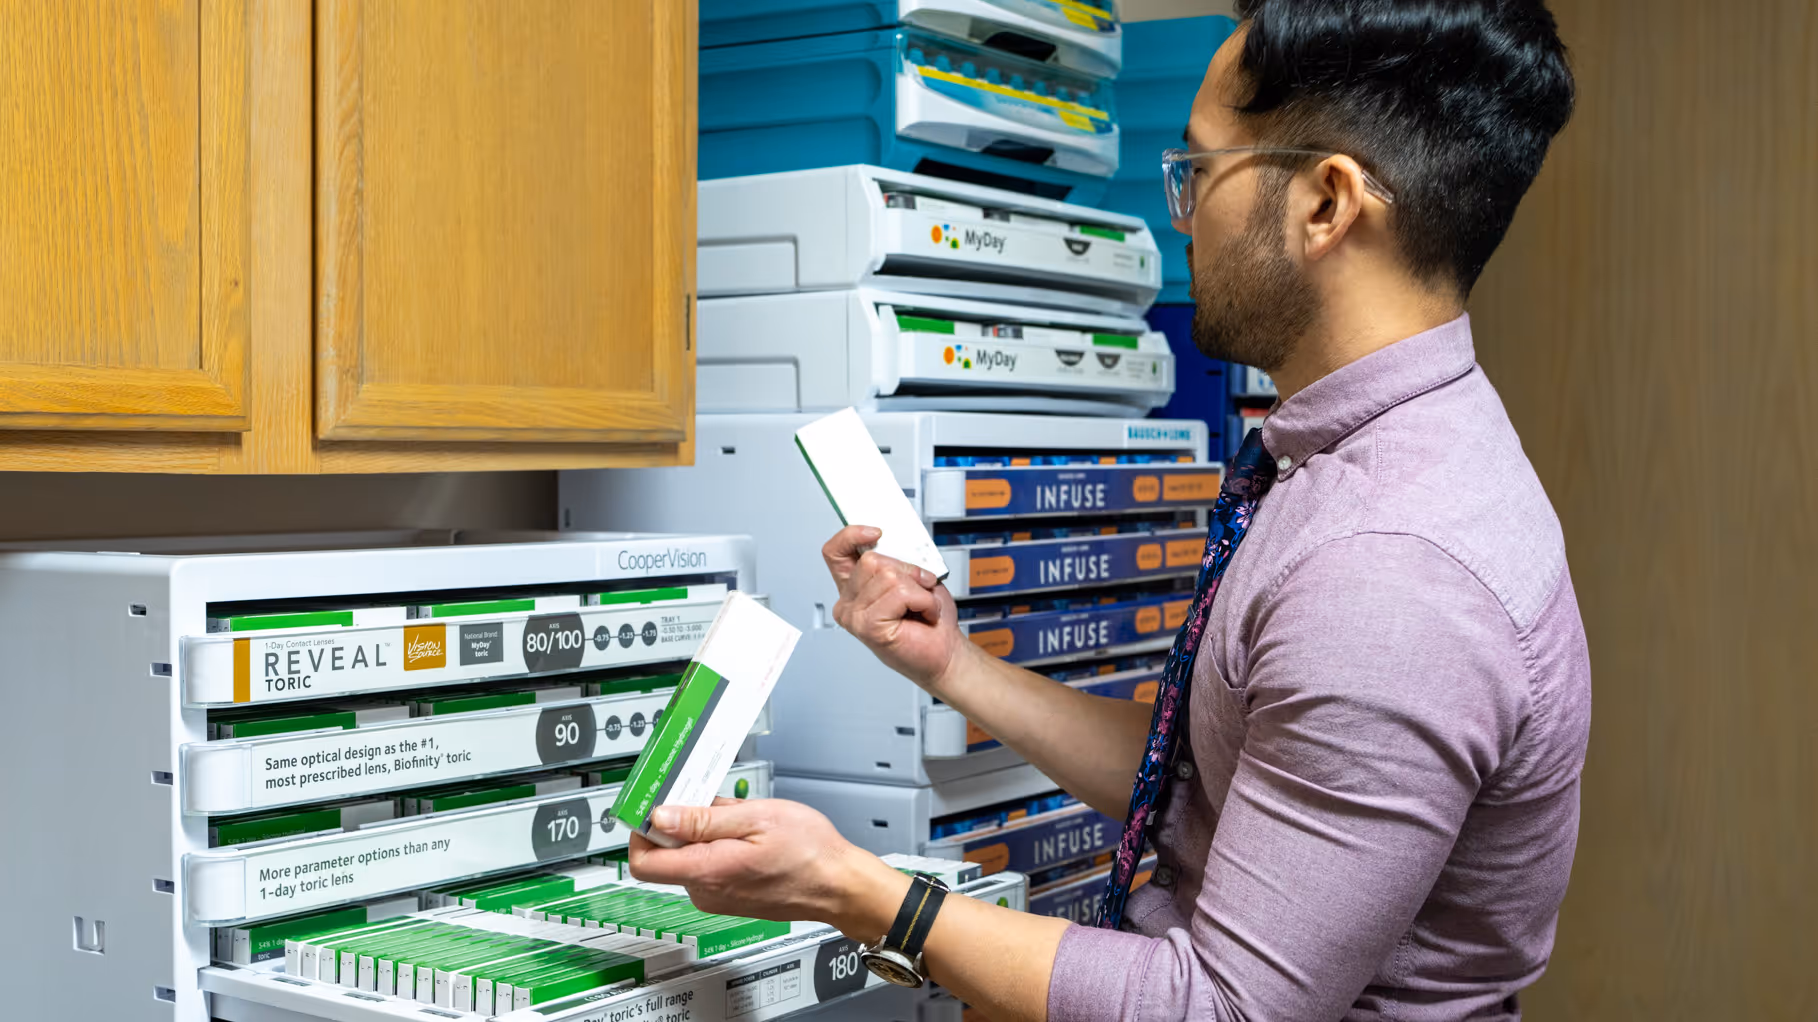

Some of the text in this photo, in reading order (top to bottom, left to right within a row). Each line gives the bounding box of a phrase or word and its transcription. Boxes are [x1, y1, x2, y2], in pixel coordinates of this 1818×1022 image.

[976, 348, 1017, 372] MyDay
[1036, 483, 1106, 511] INFUSE
[617, 547, 708, 575] CooperVision
[1039, 553, 1110, 585] INFUSE
[464, 630, 498, 640] National Brand
[548, 622, 560, 630] AXIS
[594, 633, 610, 642] -0.75
[619, 631, 634, 640] -1.25
[642, 629, 657, 638] -1.75
[1038, 620, 1110, 655] INFUSE
[264, 638, 335, 651] 1-Day Contact Lenses
[526, 629, 582, 655] 80/100
[264, 674, 312, 693] TORIC
[554, 721, 580, 747] 90
[606, 723, 621, 732] -0.75
[630, 719, 645, 729] -1.25
[265, 737, 439, 771] Same optical design as the #1,
[658, 747, 677, 774] Silicone
[673, 716, 694, 749] Hydrogel
[265, 773, 296, 789] most
[299, 763, 362, 788] prescribed
[364, 762, 391, 775] lens,
[446, 749, 472, 764] toric
[547, 815, 580, 842] 170
[1034, 823, 1104, 864] INFUSE
[258, 838, 451, 882] More parameter options than any
[259, 871, 355, 900] 1-day toric lens
[257, 951, 271, 961] toric
[838, 945, 849, 953] AXIS
[828, 951, 859, 981] 180
[645, 995, 663, 1013] full
[665, 990, 694, 1007] range
[666, 1008, 690, 1022] toric
